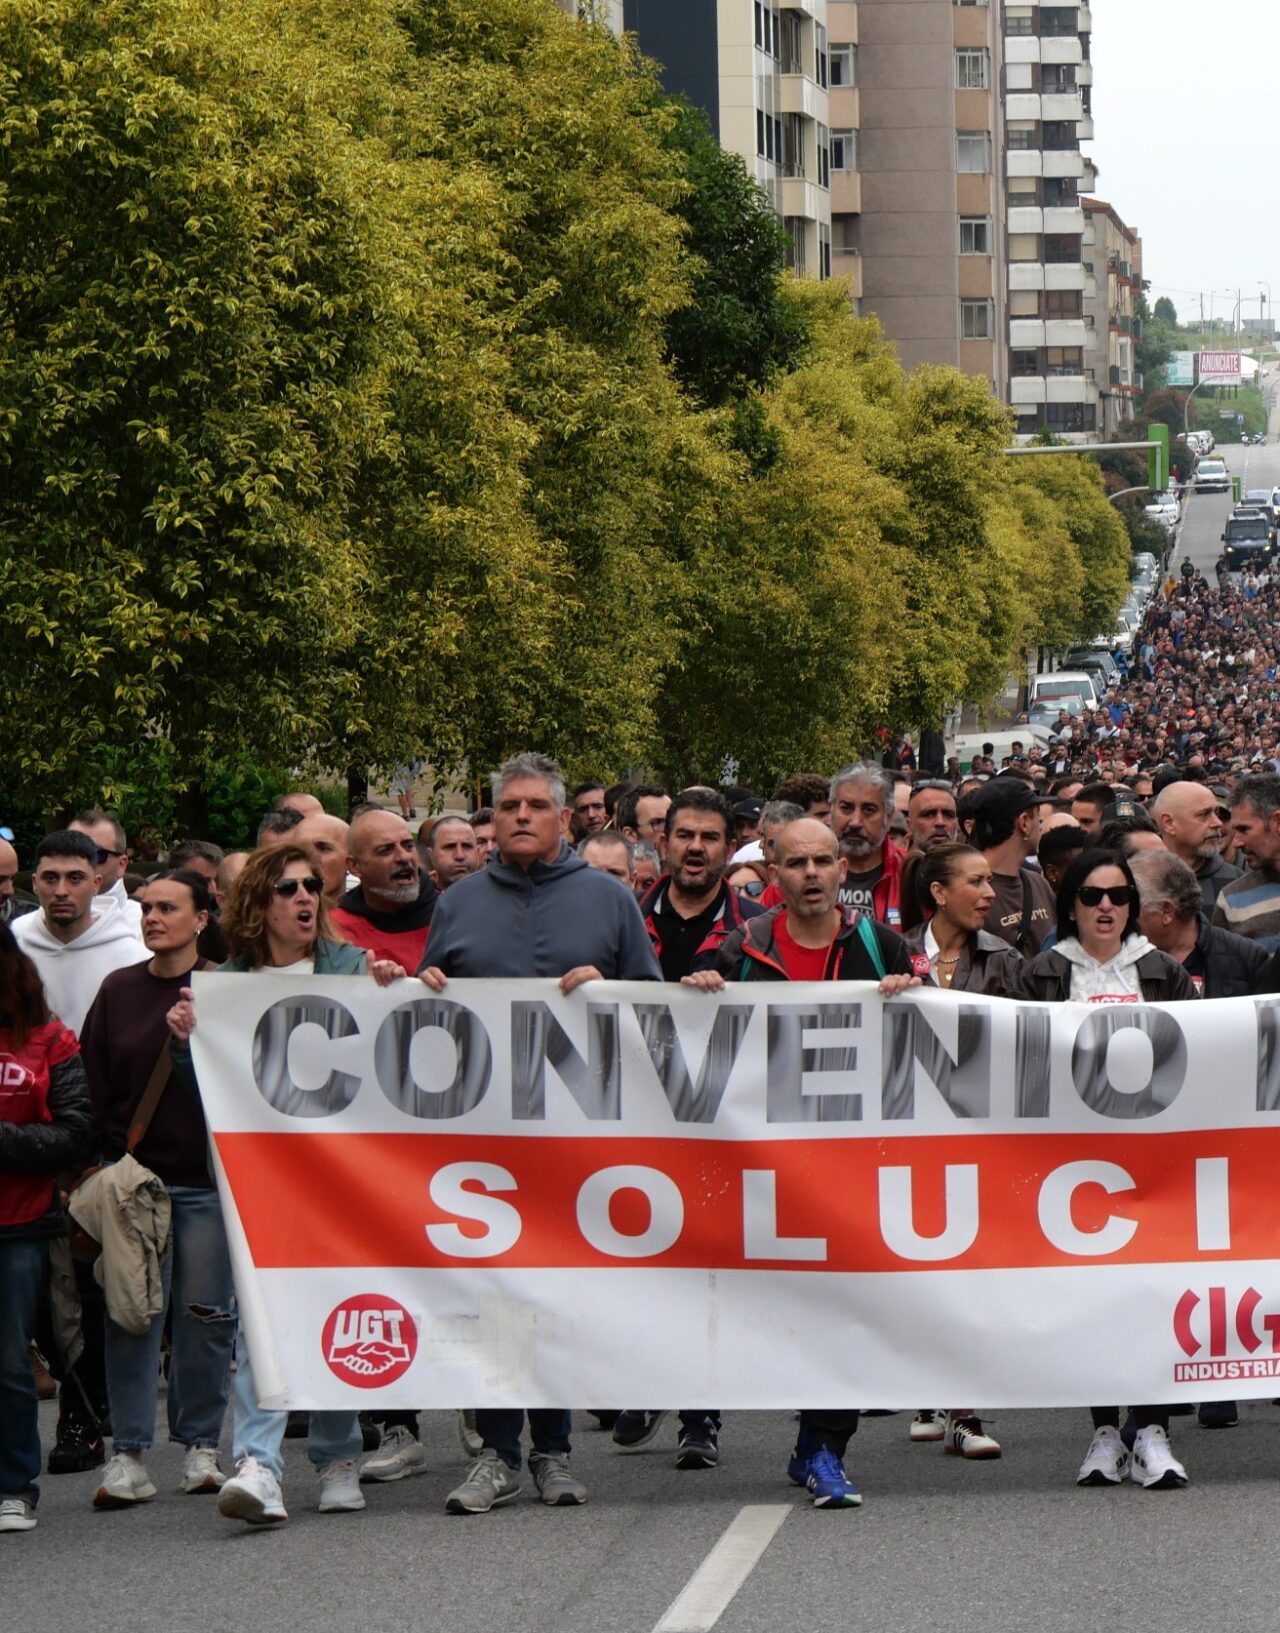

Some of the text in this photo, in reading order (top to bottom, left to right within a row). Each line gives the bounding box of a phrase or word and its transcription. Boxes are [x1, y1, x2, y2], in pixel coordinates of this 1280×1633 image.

[1000, 908, 1050, 927] carrtt
[252, 994, 1188, 1124] CONVENIO
[332, 1309, 405, 1349] UGT
